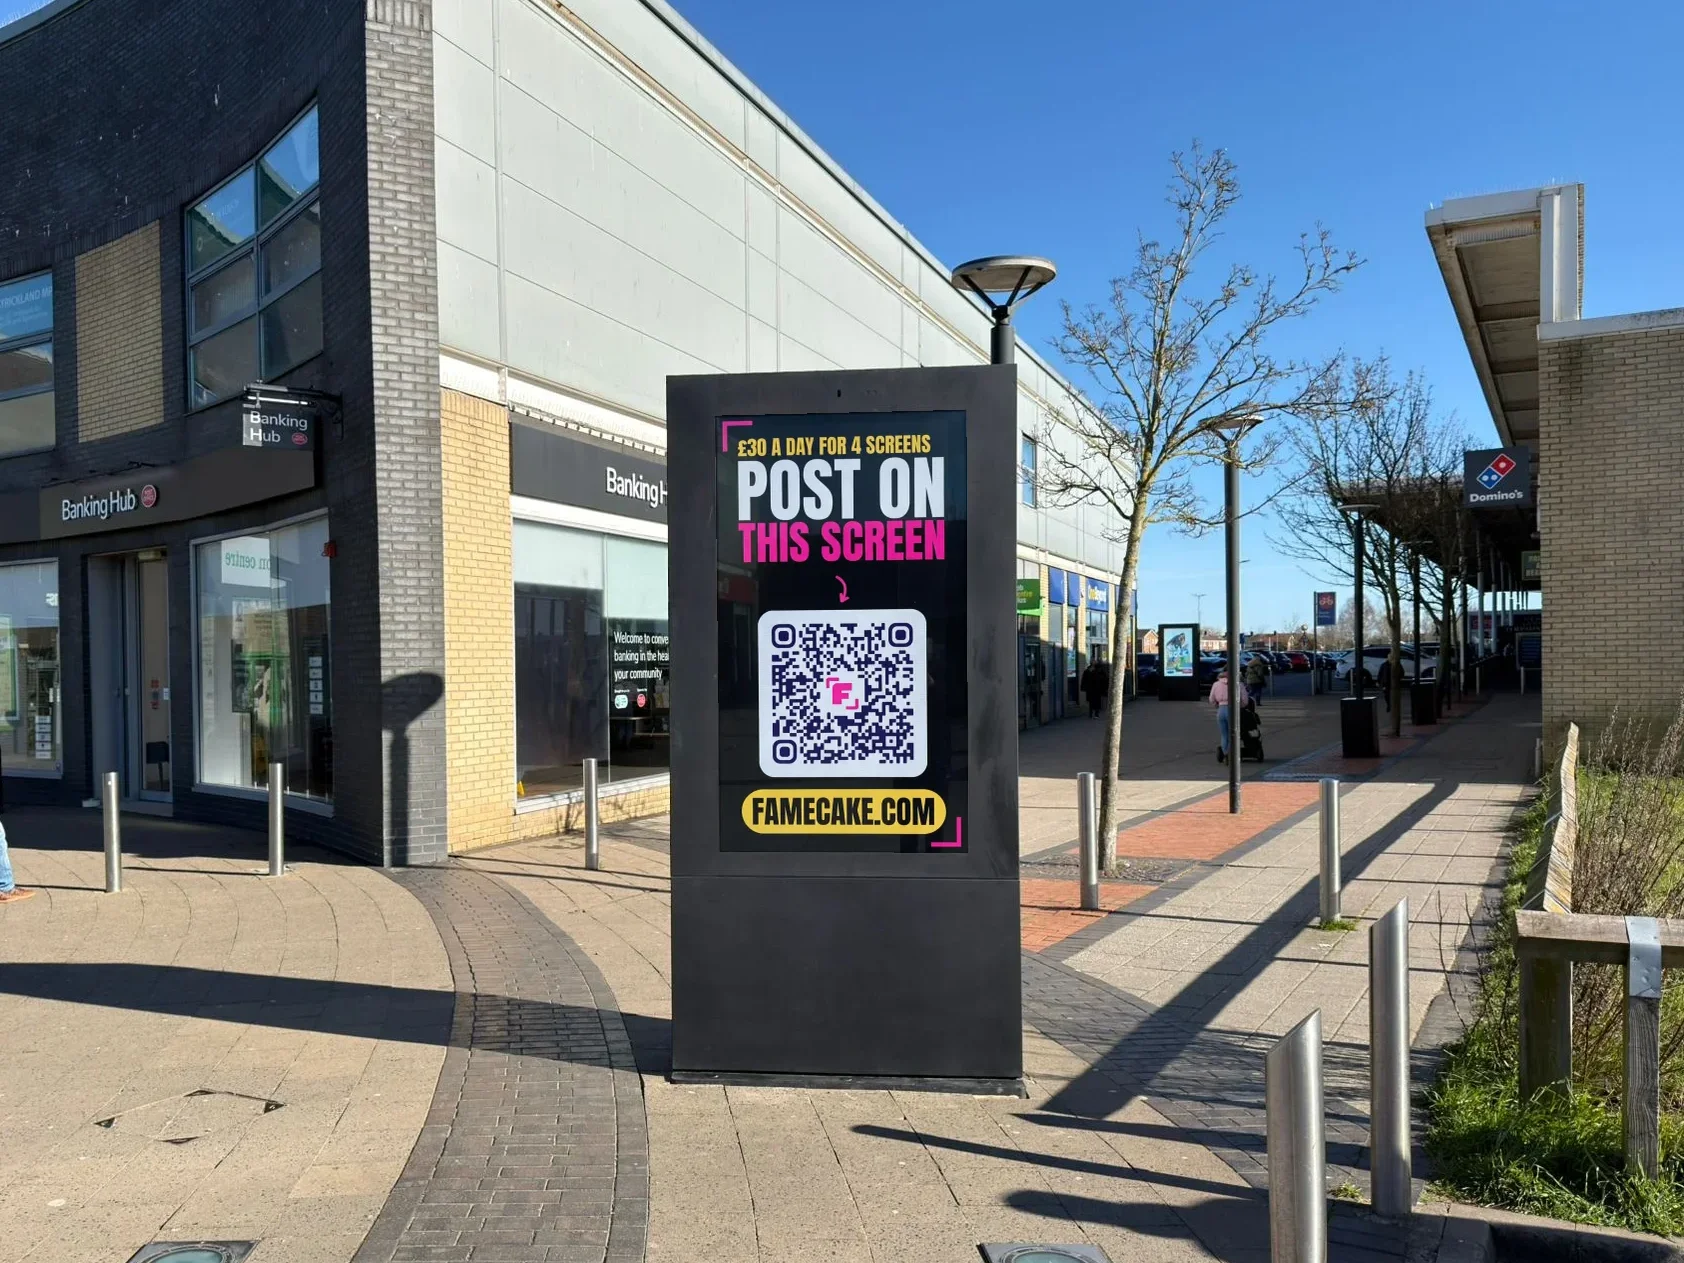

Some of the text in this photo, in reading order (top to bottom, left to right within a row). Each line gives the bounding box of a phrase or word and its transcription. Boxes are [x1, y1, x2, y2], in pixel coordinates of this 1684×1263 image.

[250, 410, 308, 431] Banking
[250, 427, 281, 442] Hub
[737, 434, 931, 457] £30 A DAY FOR 4 SCREENS
[606, 466, 658, 508] Banking
[737, 456, 945, 521] POST ON
[1470, 489, 1524, 502] Domino's
[62, 495, 108, 520] Banking
[110, 488, 136, 513] Hub
[738, 519, 946, 563] THIS SCREEN
[613, 631, 643, 644] Welcome
[644, 633, 651, 644] to
[613, 649, 639, 664] banking
[639, 650, 646, 661] in
[646, 650, 657, 661] the
[614, 667, 663, 682] your community
[832, 682, 853, 705] F
[752, 796, 935, 826] FAMECAKE.COM
